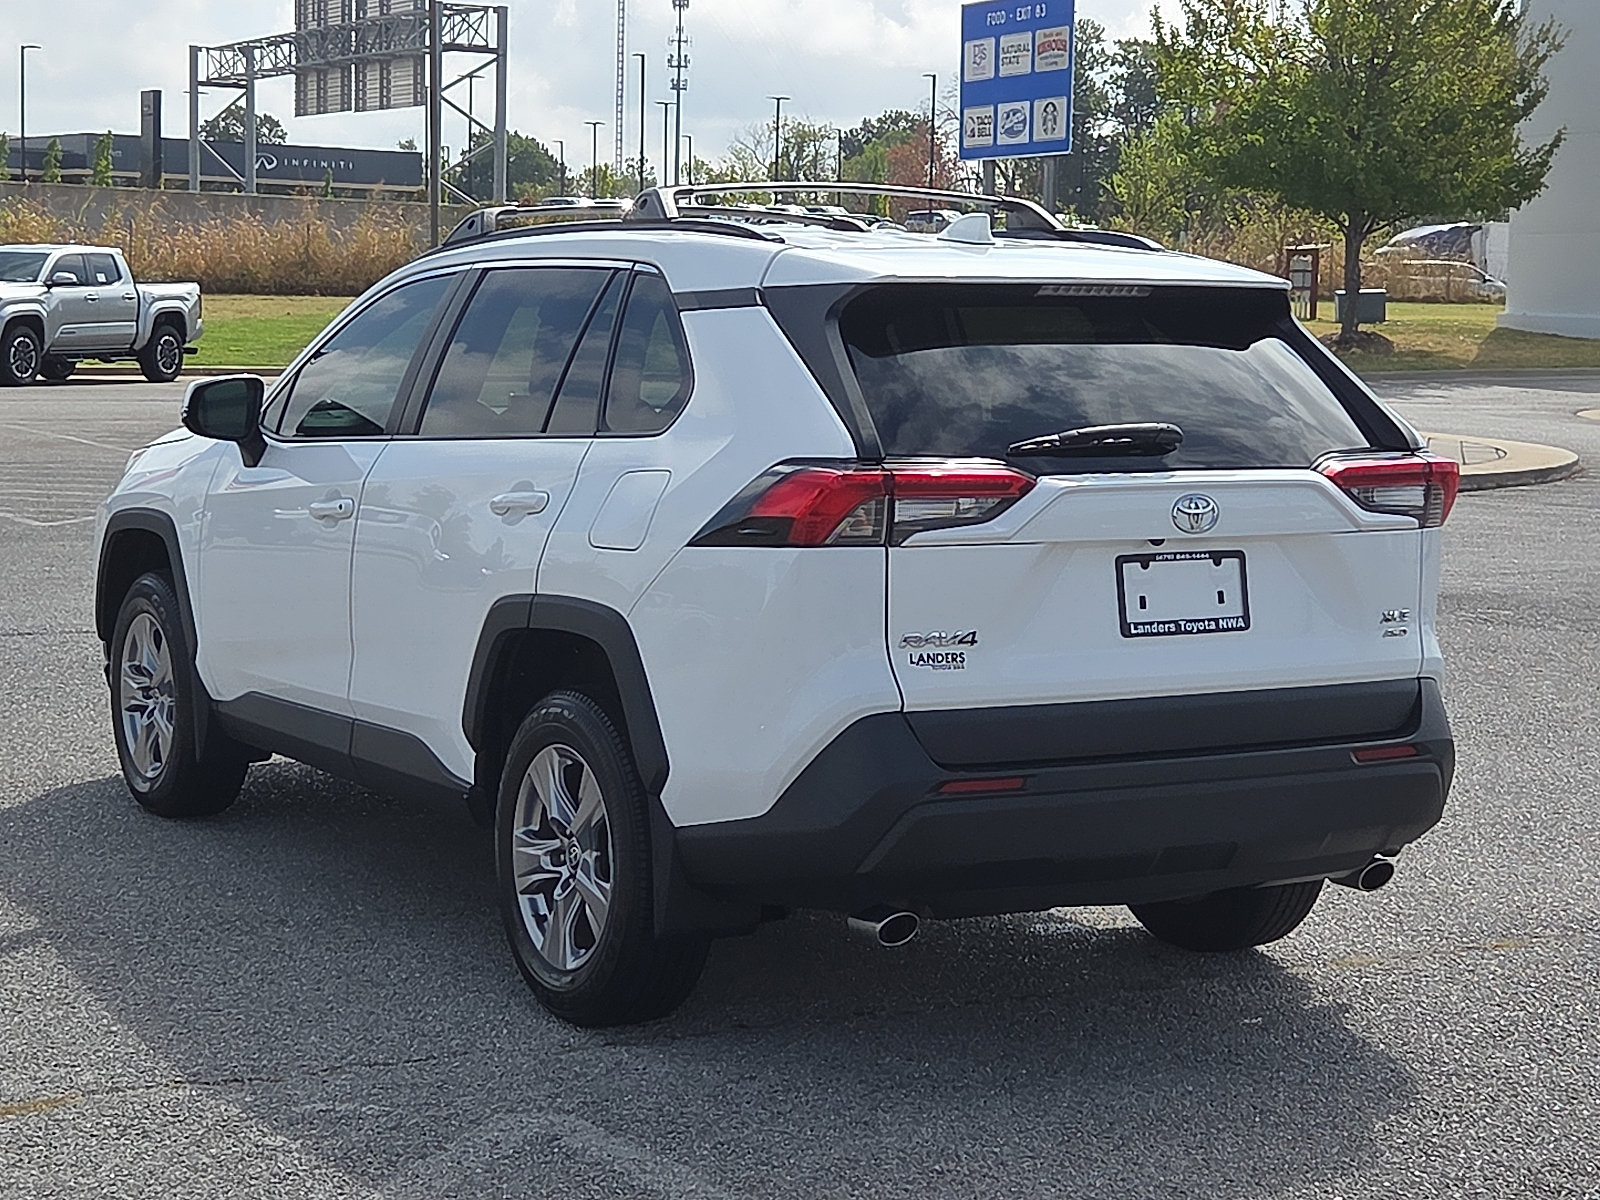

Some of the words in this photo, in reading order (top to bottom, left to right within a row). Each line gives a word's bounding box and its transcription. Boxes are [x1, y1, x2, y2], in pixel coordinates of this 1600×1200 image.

[987, 10, 1006, 26] FOOD
[1016, 5, 1032, 21] EXIT
[1001, 43, 1030, 55] NATURAL
[1001, 55, 1020, 66] STATE
[284, 158, 355, 170] INFINITI
[1130, 622, 1176, 634] Landers
[1178, 620, 1216, 633] Toyota
[1219, 617, 1246, 629] NWA
[909, 651, 966, 667] LANDERS
